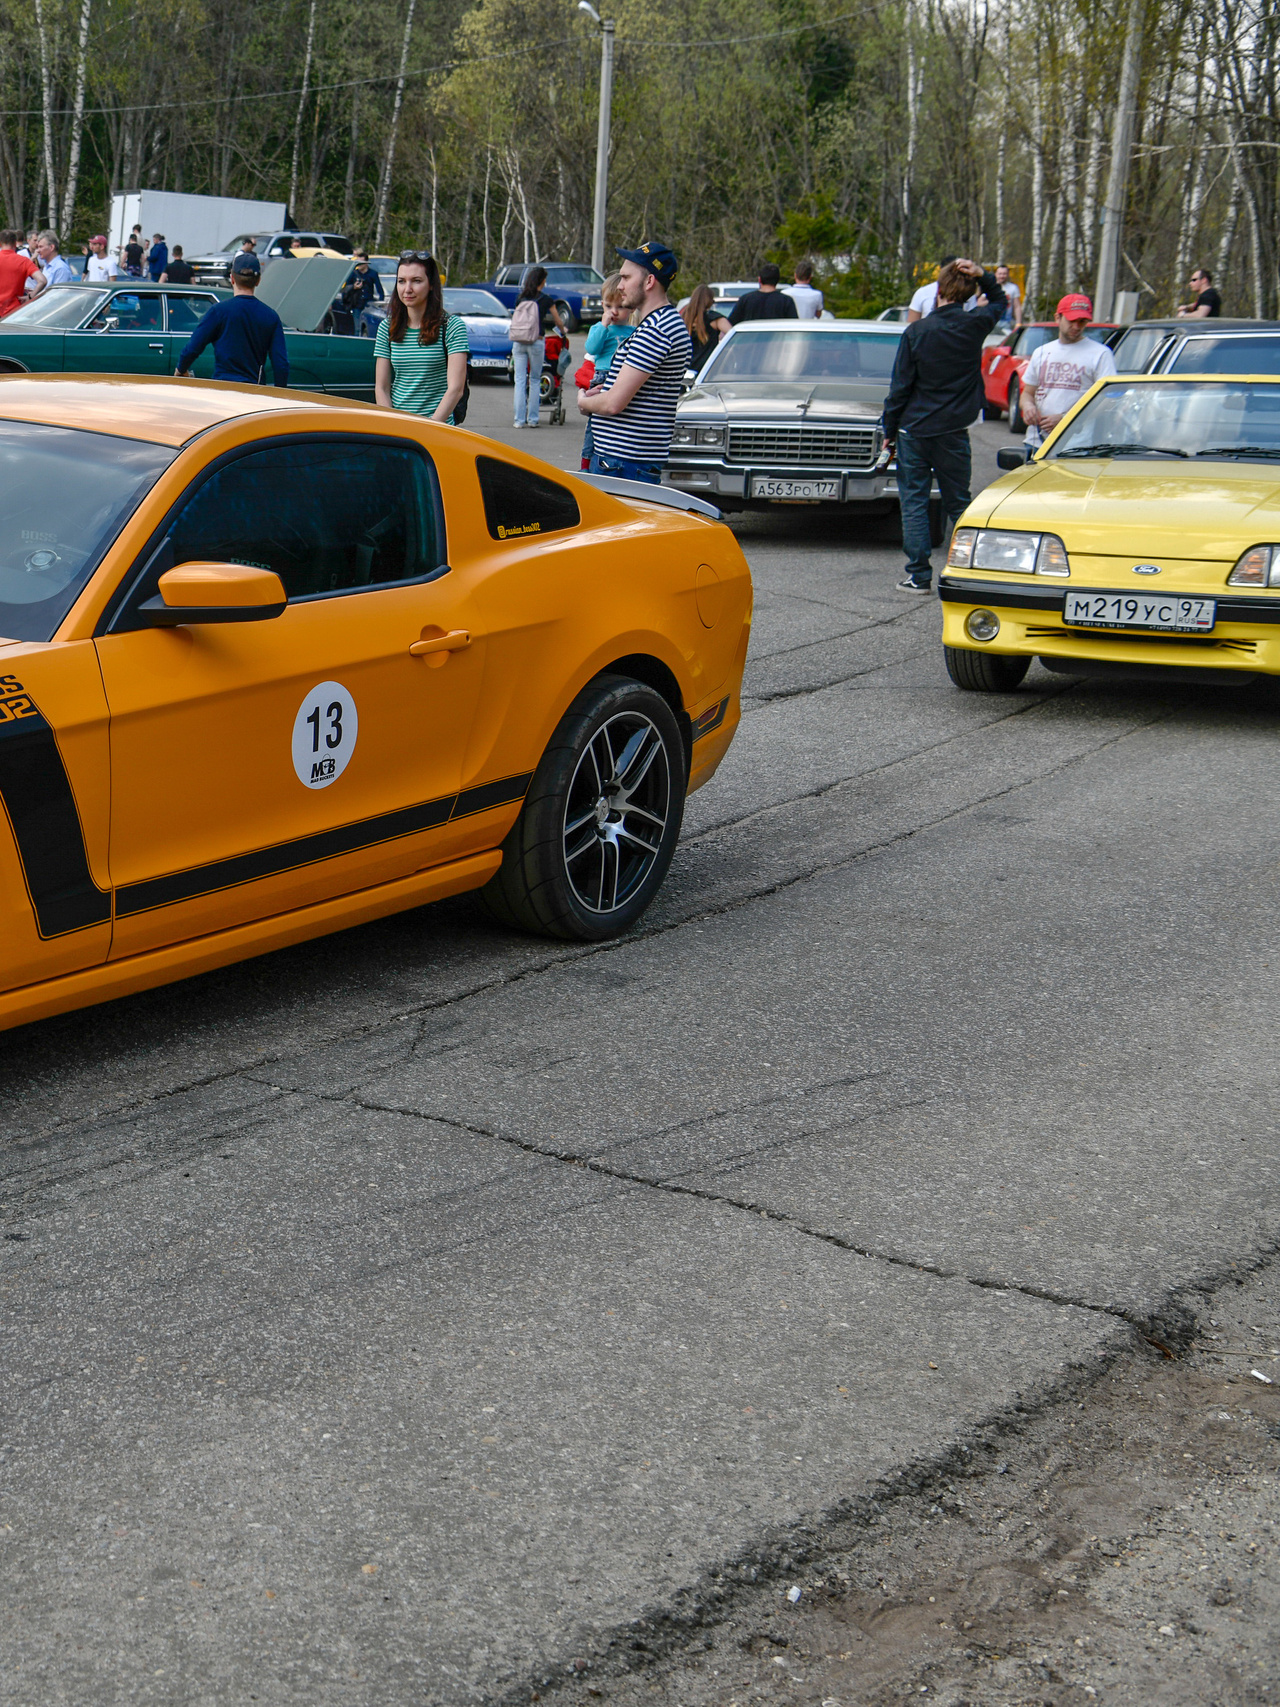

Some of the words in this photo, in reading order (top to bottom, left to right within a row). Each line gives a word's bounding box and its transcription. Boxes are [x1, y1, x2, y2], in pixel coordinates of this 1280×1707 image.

[1048, 362, 1086, 376] FROM
[1047, 372, 1082, 385] RUSSIA
[757, 482, 812, 497] А563РО
[814, 482, 834, 494] 177
[1073, 597, 1173, 622] М219УС
[1181, 601, 1205, 618] 97
[1178, 616, 1196, 625] RUS
[307, 701, 343, 752] 13
